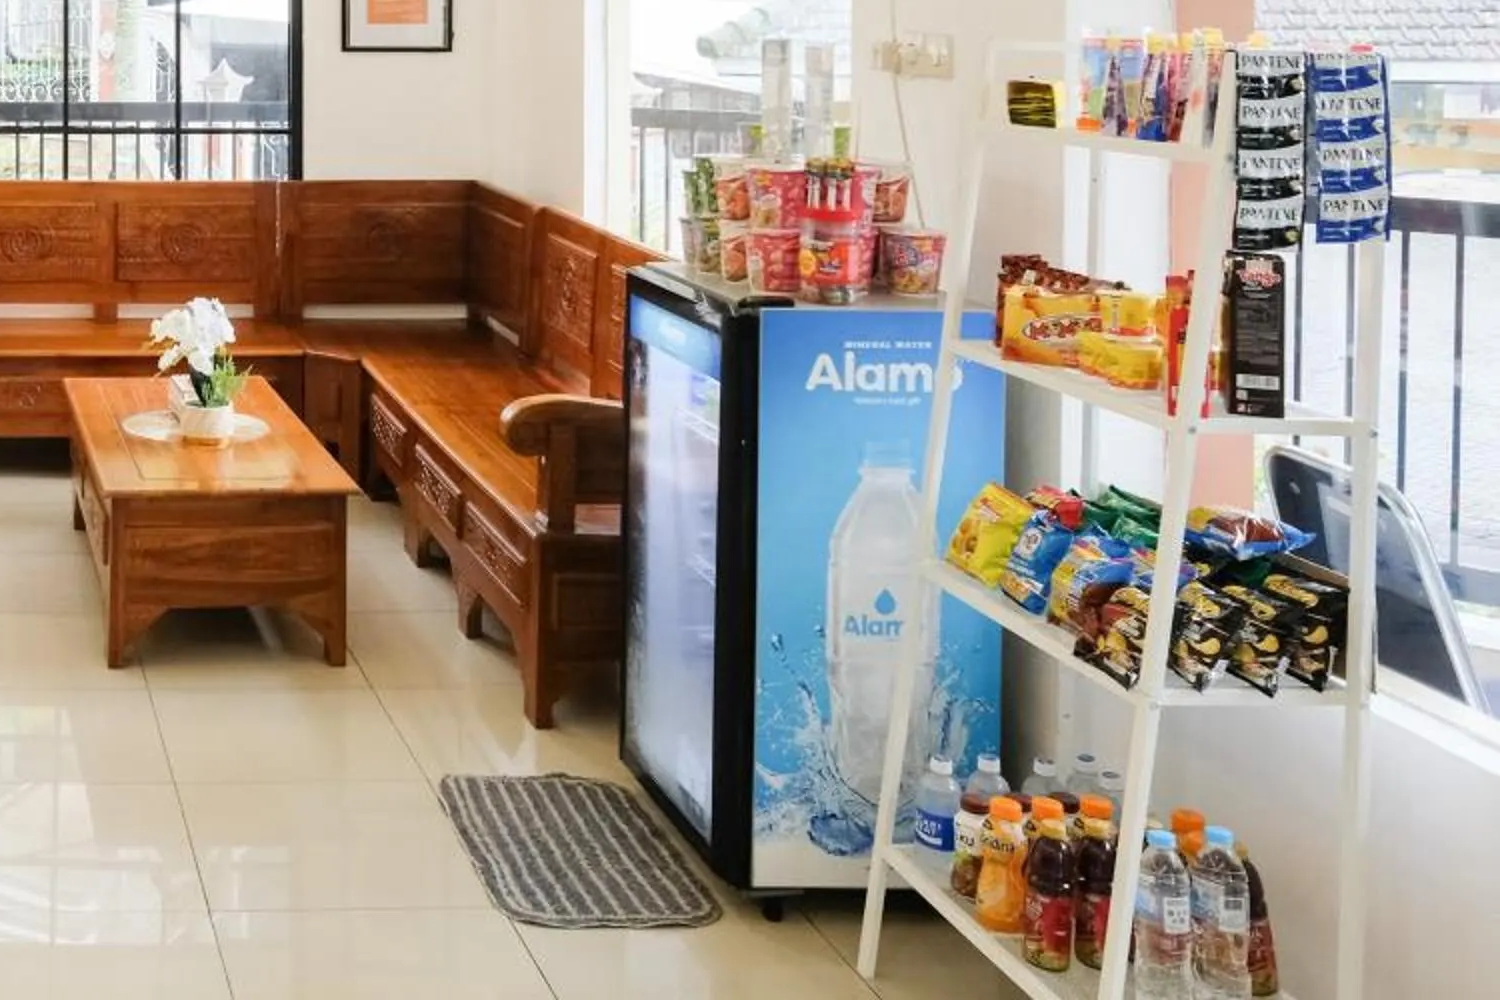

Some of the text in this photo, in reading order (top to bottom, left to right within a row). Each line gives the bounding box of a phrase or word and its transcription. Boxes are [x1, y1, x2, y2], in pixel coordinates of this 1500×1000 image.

[1240, 55, 1299, 71] PANTENE
[843, 341, 932, 349] MINERAL WATER
[844, 614, 905, 637] Alam
